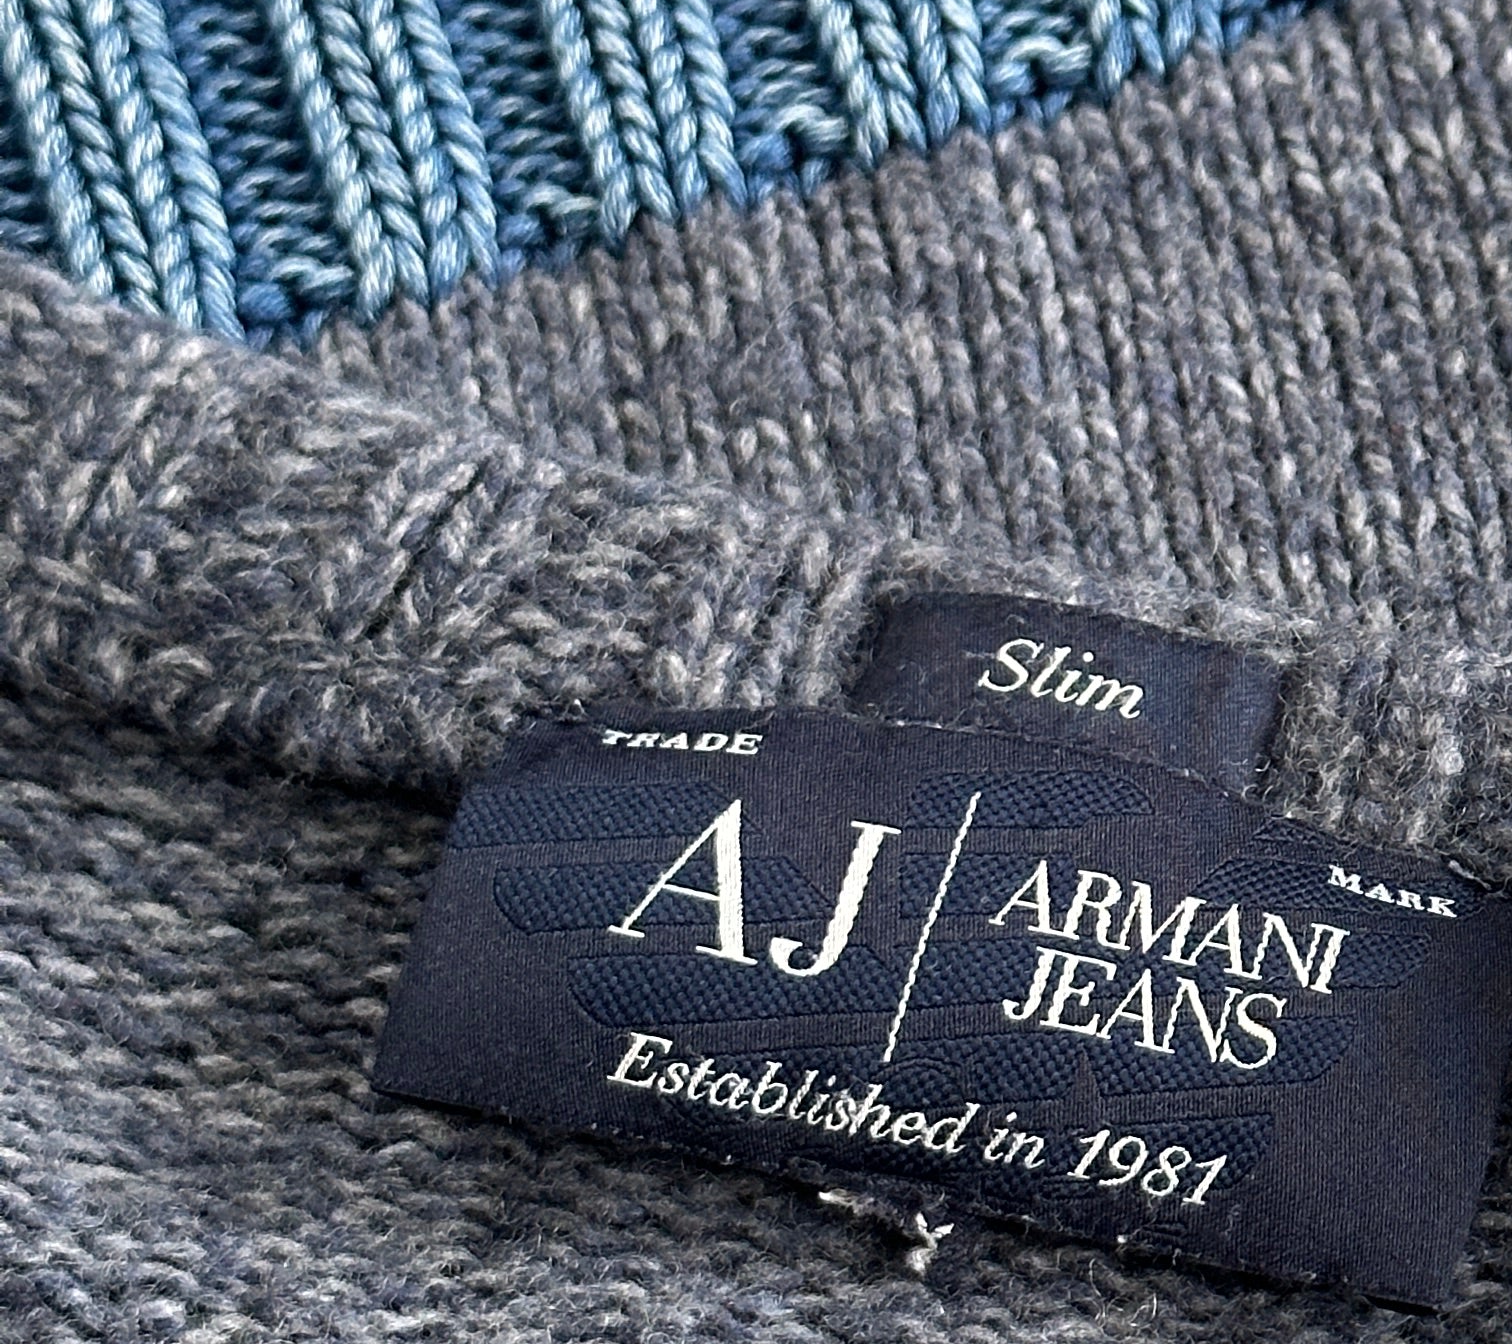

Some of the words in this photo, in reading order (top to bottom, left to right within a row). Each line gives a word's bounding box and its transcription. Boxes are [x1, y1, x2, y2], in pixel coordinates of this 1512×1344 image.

[601, 728, 764, 756] TRADE
[977, 638, 1145, 720] Slim
[606, 797, 903, 979] AJ
[988, 858, 1352, 996] ARMANI
[1326, 863, 1459, 919] MARK
[1000, 944, 1289, 1071] JEANS
[605, 1030, 982, 1155] Established
[983, 1110, 1046, 1170] in
[1065, 1128, 1229, 1207] 1981
